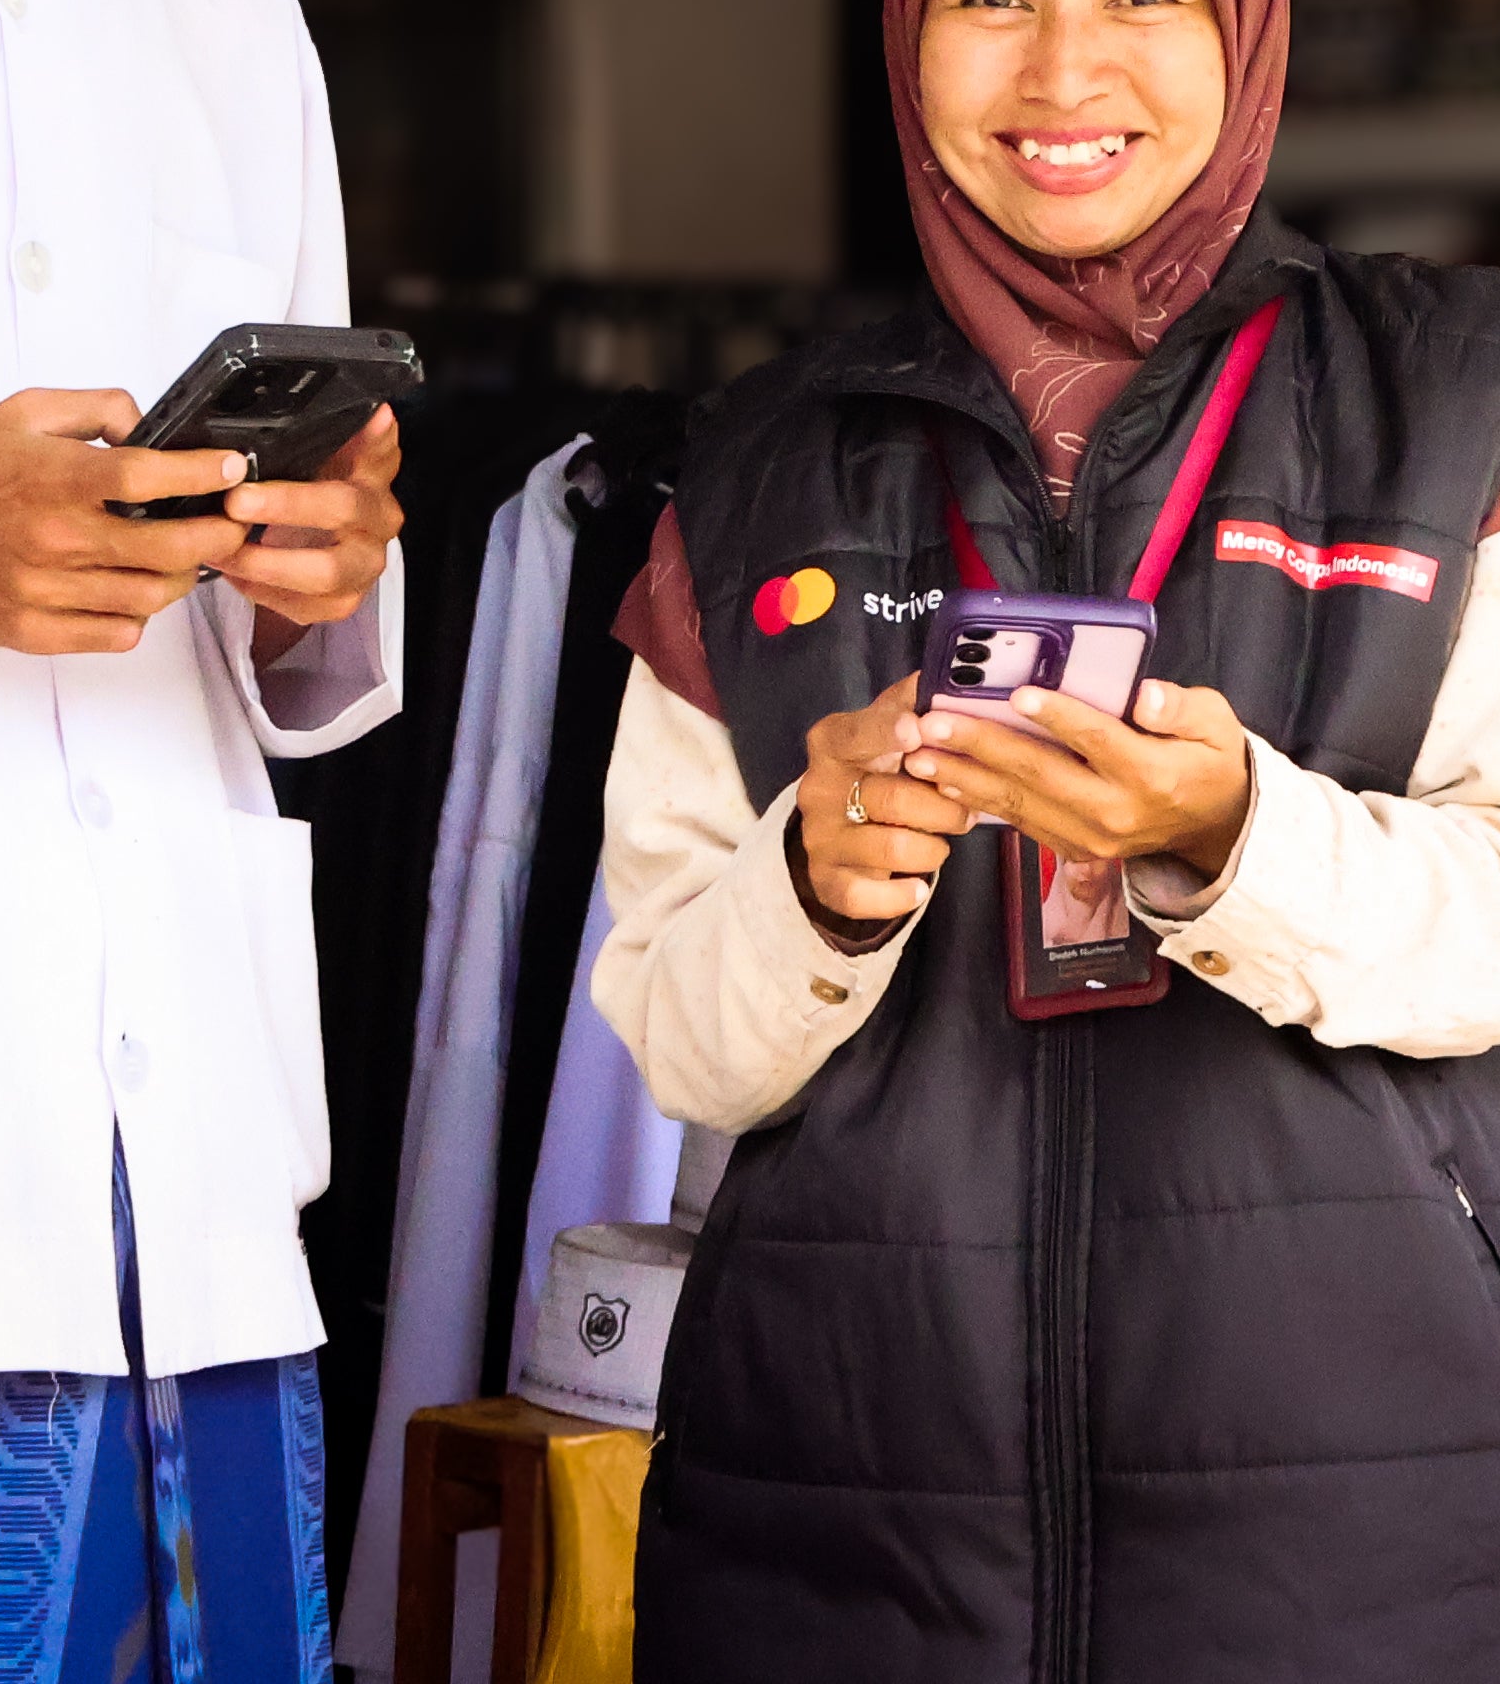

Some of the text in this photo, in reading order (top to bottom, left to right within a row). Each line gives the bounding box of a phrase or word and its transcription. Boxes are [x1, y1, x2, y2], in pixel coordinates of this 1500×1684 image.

[1221, 530, 1429, 588] Mercy Corps Indonesia
[863, 588, 944, 624] strive
